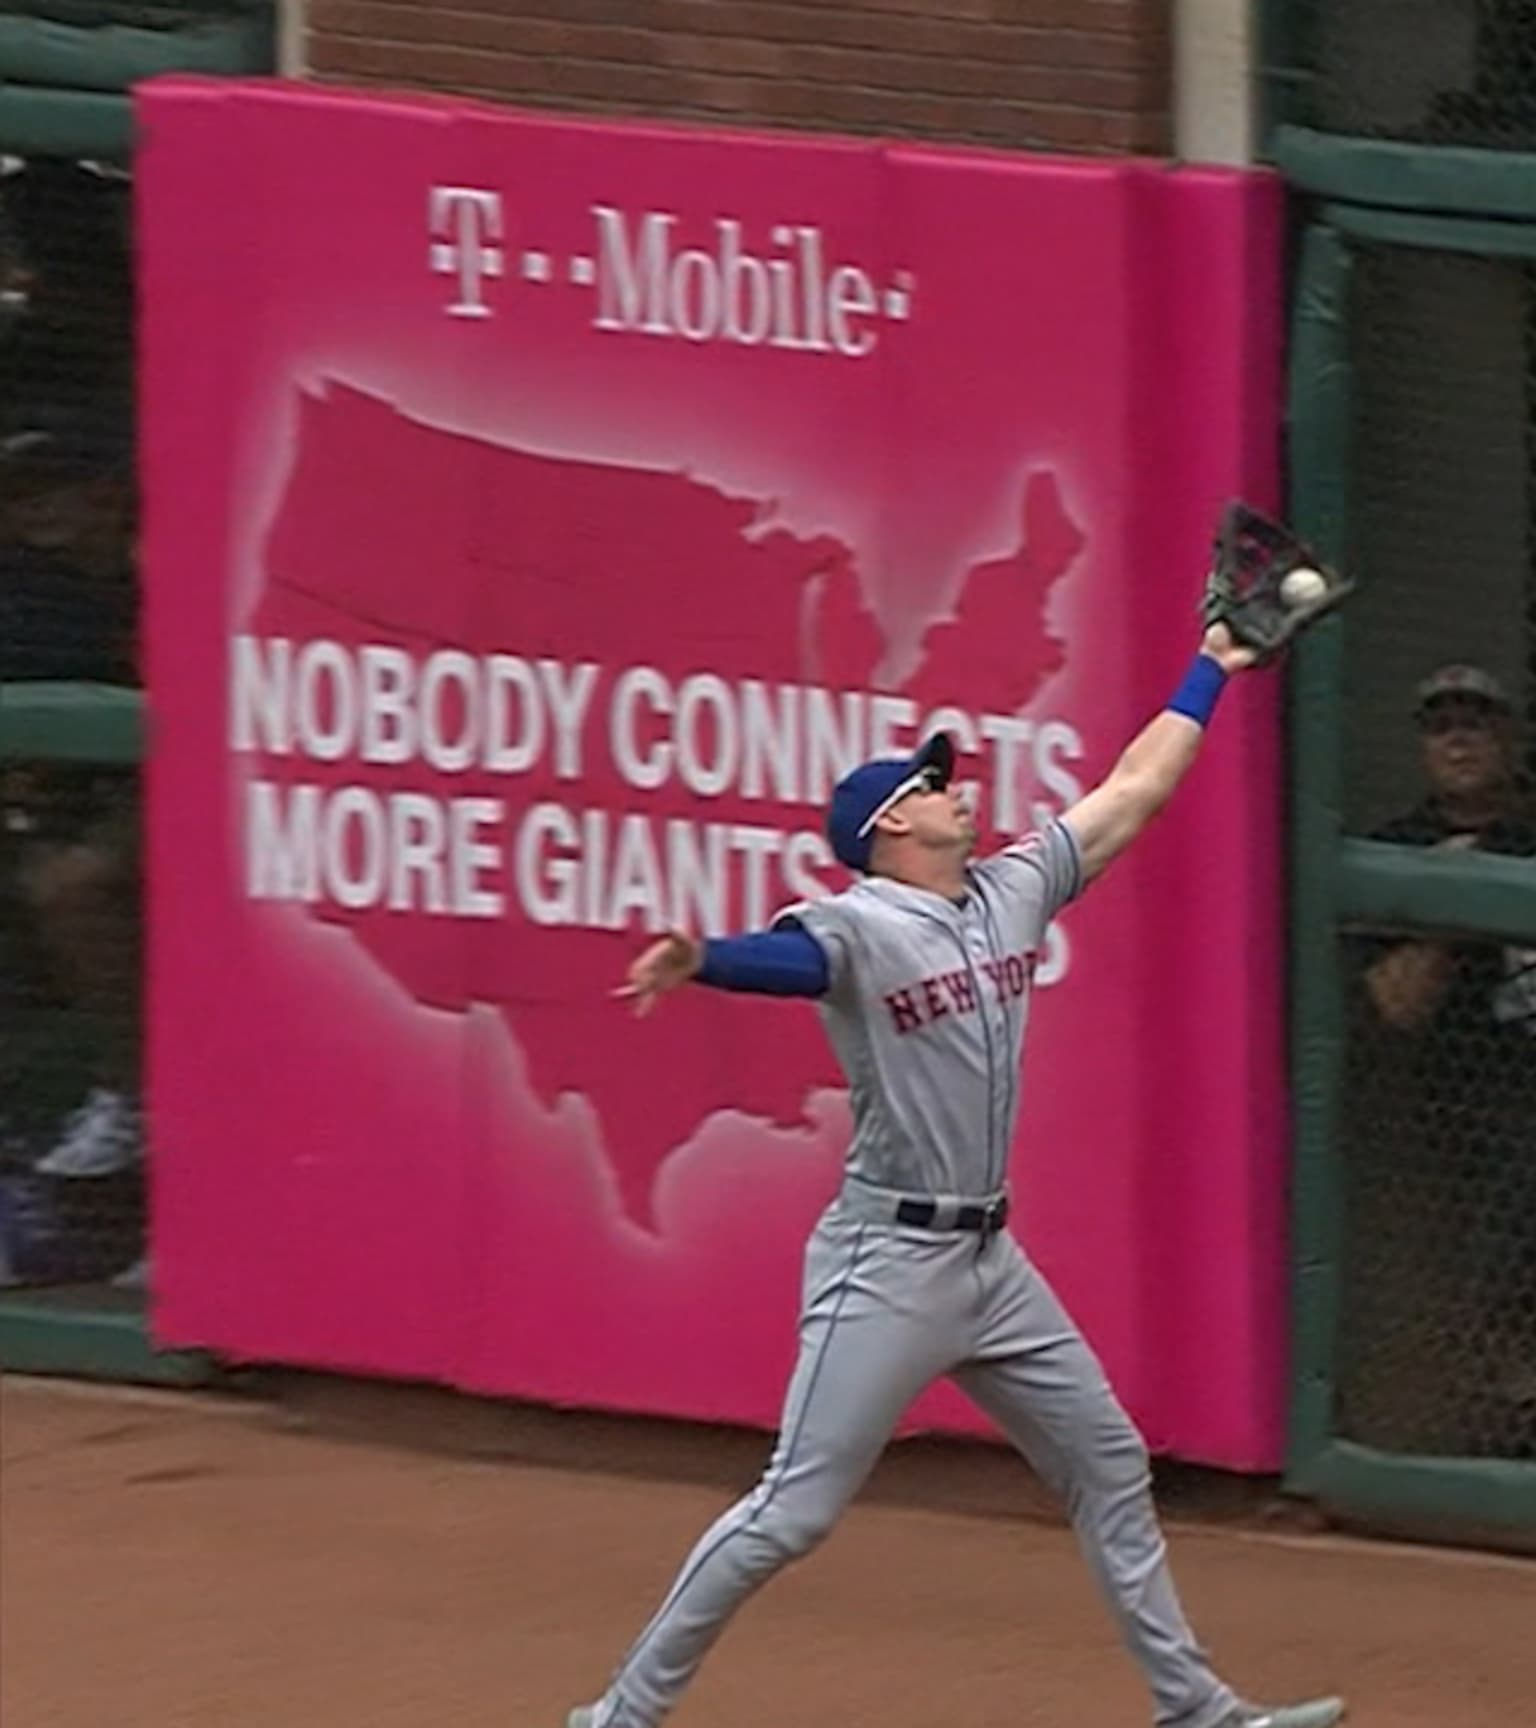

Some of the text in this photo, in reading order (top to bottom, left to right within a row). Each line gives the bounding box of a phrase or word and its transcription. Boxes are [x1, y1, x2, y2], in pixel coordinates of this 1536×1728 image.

[231, 635, 600, 779] NOBODY
[248, 781, 842, 935] MORE GIANTS
[884, 969, 976, 1034] NEW
